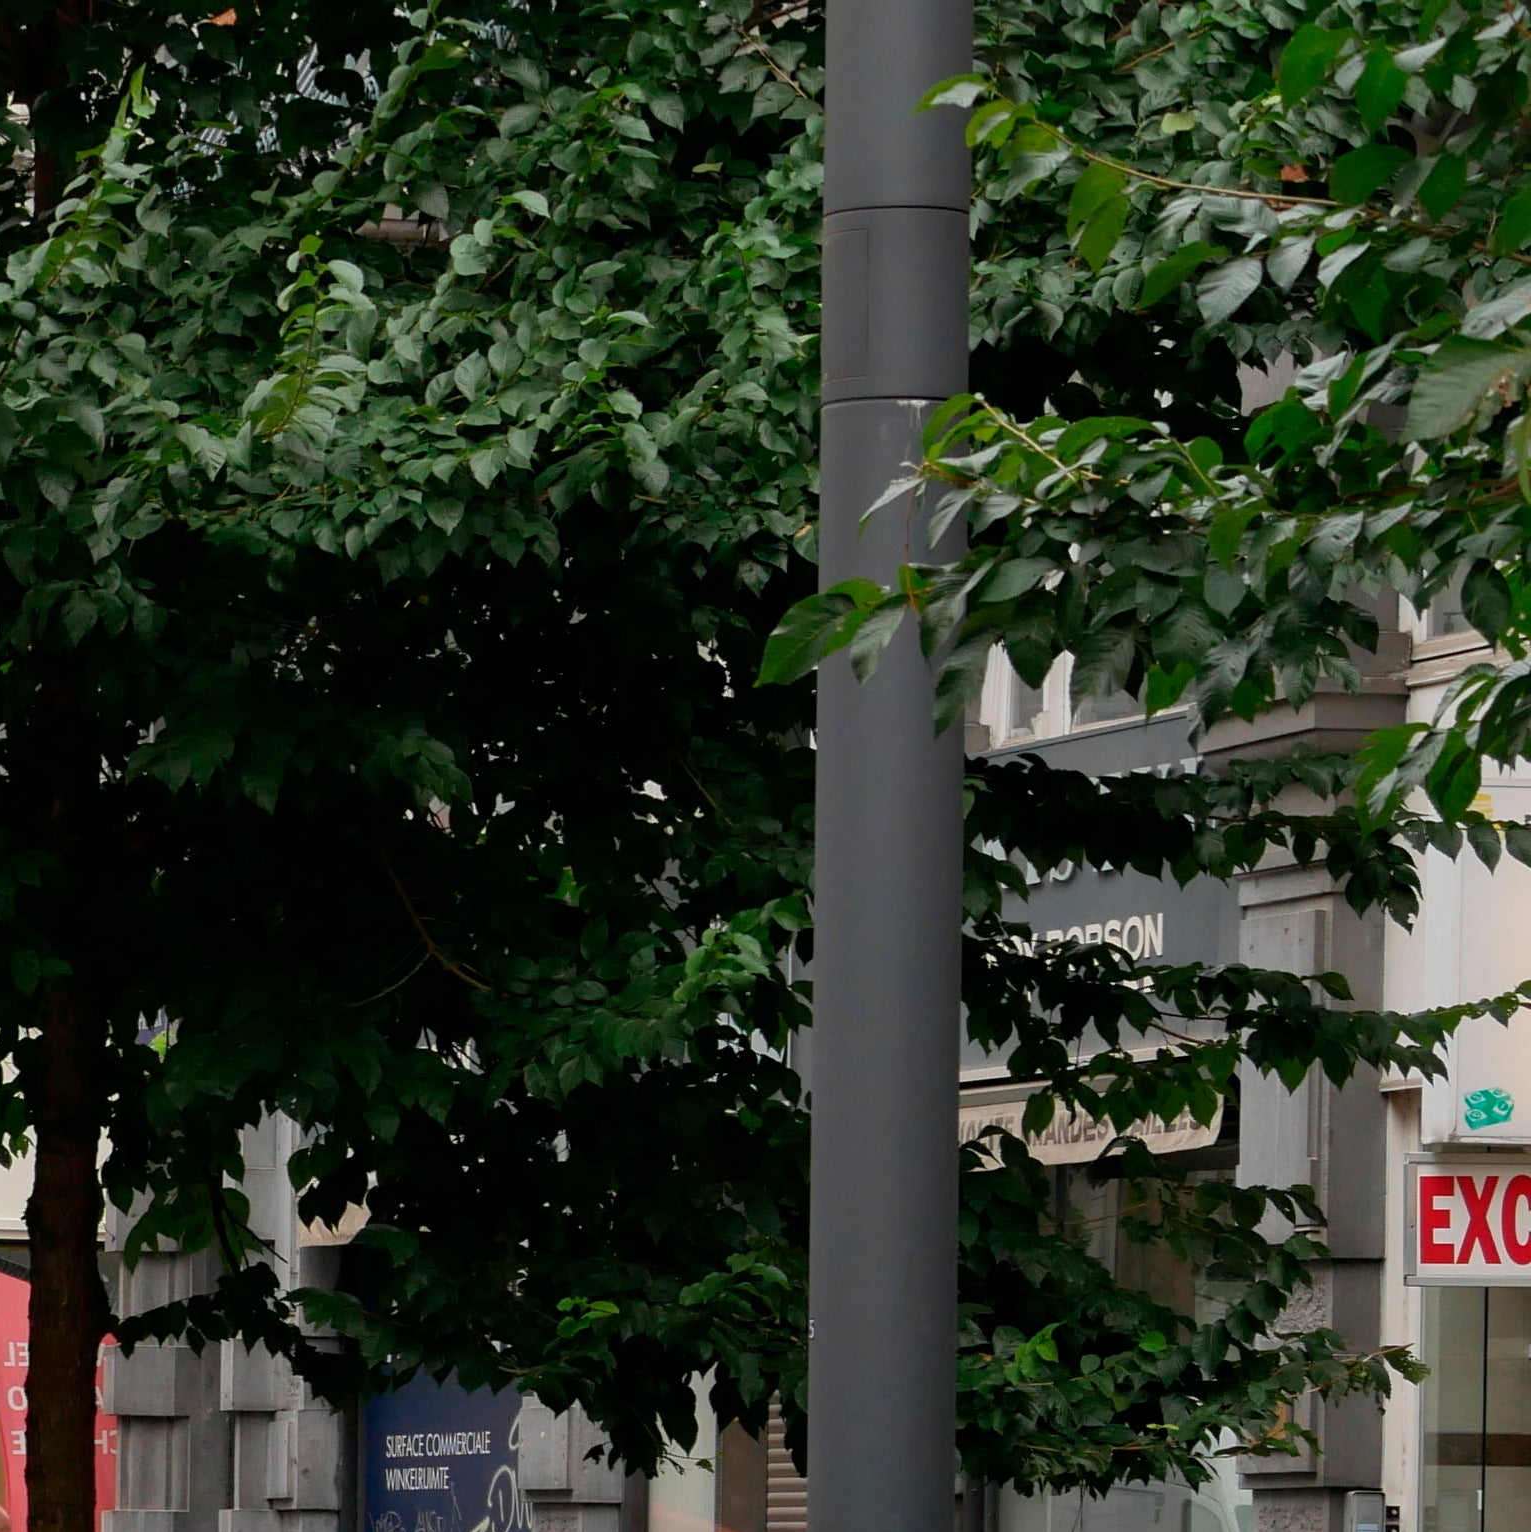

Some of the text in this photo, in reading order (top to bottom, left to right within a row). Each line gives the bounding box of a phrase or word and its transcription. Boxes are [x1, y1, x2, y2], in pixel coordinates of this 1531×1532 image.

[385, 1431, 491, 1458] SURFACE COMMERCIALE
[385, 1467, 450, 1491] WINKELRUIMTE
